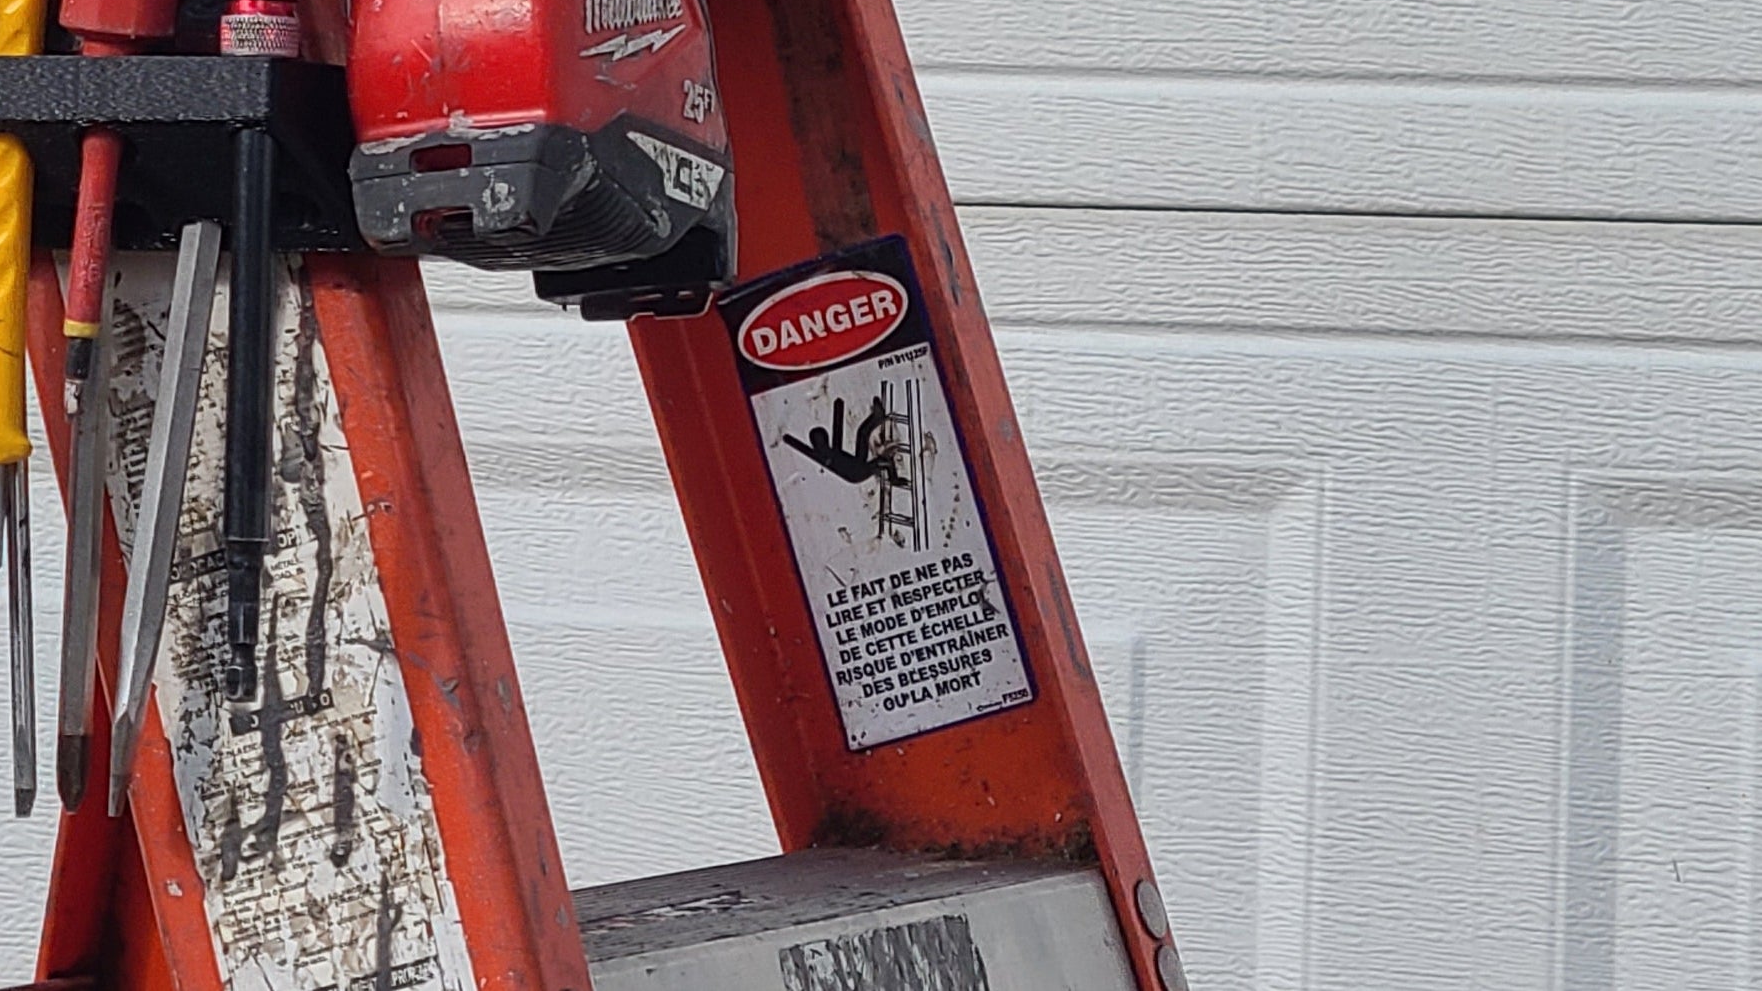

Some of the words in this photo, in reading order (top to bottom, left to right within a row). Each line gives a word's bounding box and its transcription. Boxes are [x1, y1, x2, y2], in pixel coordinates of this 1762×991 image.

[751, 288, 900, 357] DANGER
[826, 605, 863, 628] LIRE
[868, 599, 886, 616] ET
[891, 570, 986, 610] RESPECTER
[827, 590, 848, 607] LE
[852, 578, 885, 601] FAIT
[890, 570, 913, 589] DE
[915, 564, 939, 581] NE
[942, 553, 973, 574] PAS
[836, 627, 857, 645] LE
[860, 613, 907, 639] MODE
[911, 589, 988, 623] D'EMPLOI
[839, 648, 862, 664] DE
[866, 630, 917, 656] CETTE
[922, 608, 996, 640] ÉCHELLE
[836, 656, 897, 685] RISQUE
[901, 623, 1009, 666] D'ENTRAÎNER
[862, 678, 894, 698] DES
[898, 649, 993, 687] BLESSURES
[883, 694, 907, 711] OU
[911, 686, 933, 704] LA
[937, 671, 981, 696] MORT
